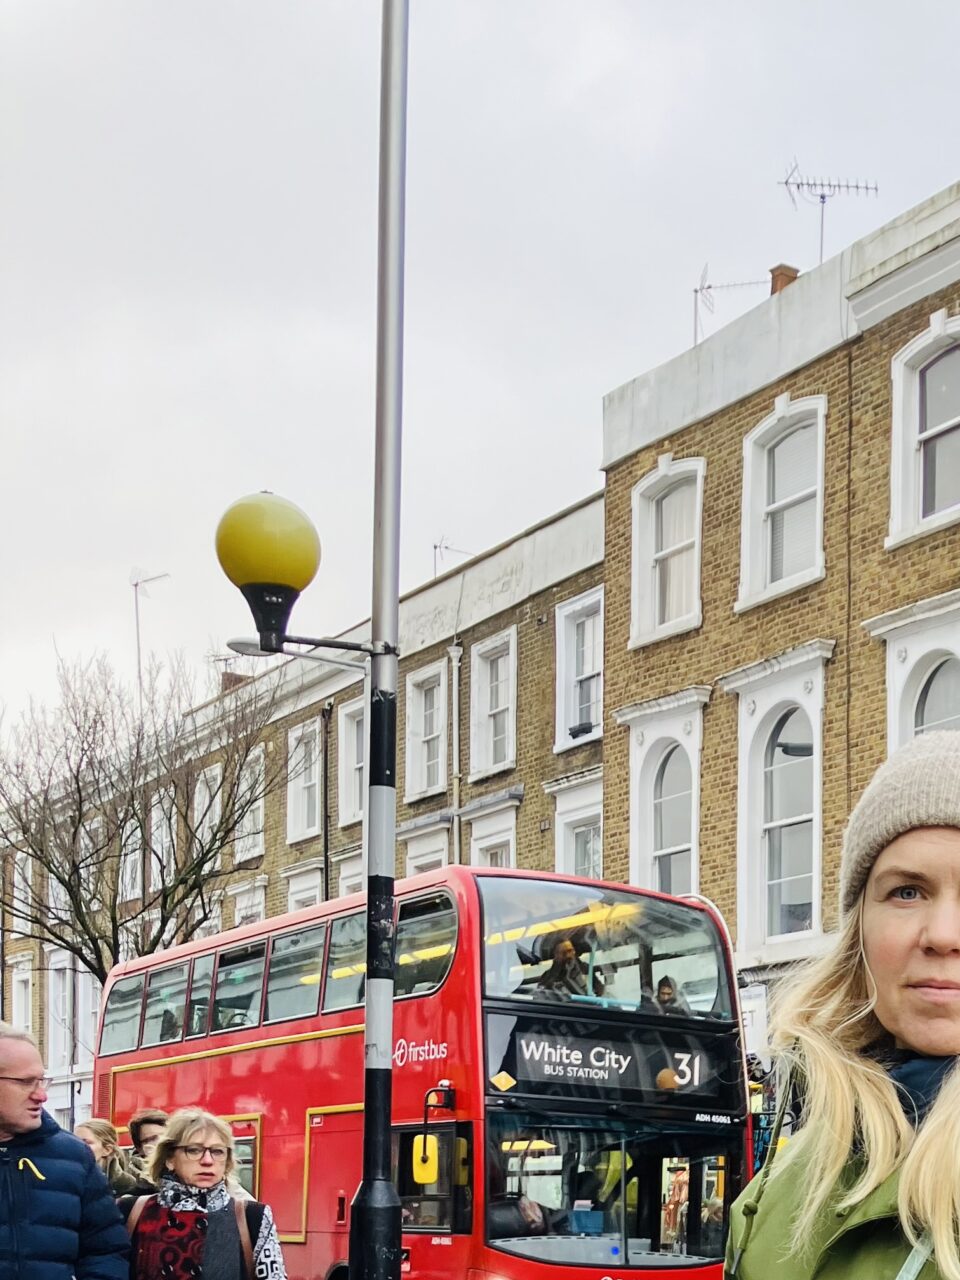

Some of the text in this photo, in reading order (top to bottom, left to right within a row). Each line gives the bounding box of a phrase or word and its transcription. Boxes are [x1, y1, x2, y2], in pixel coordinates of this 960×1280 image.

[521, 1039, 631, 1073] White City
[544, 1065, 609, 1080] BUS STATION
[674, 1053, 699, 1086] 31
[695, 1113, 711, 1122] ADH
